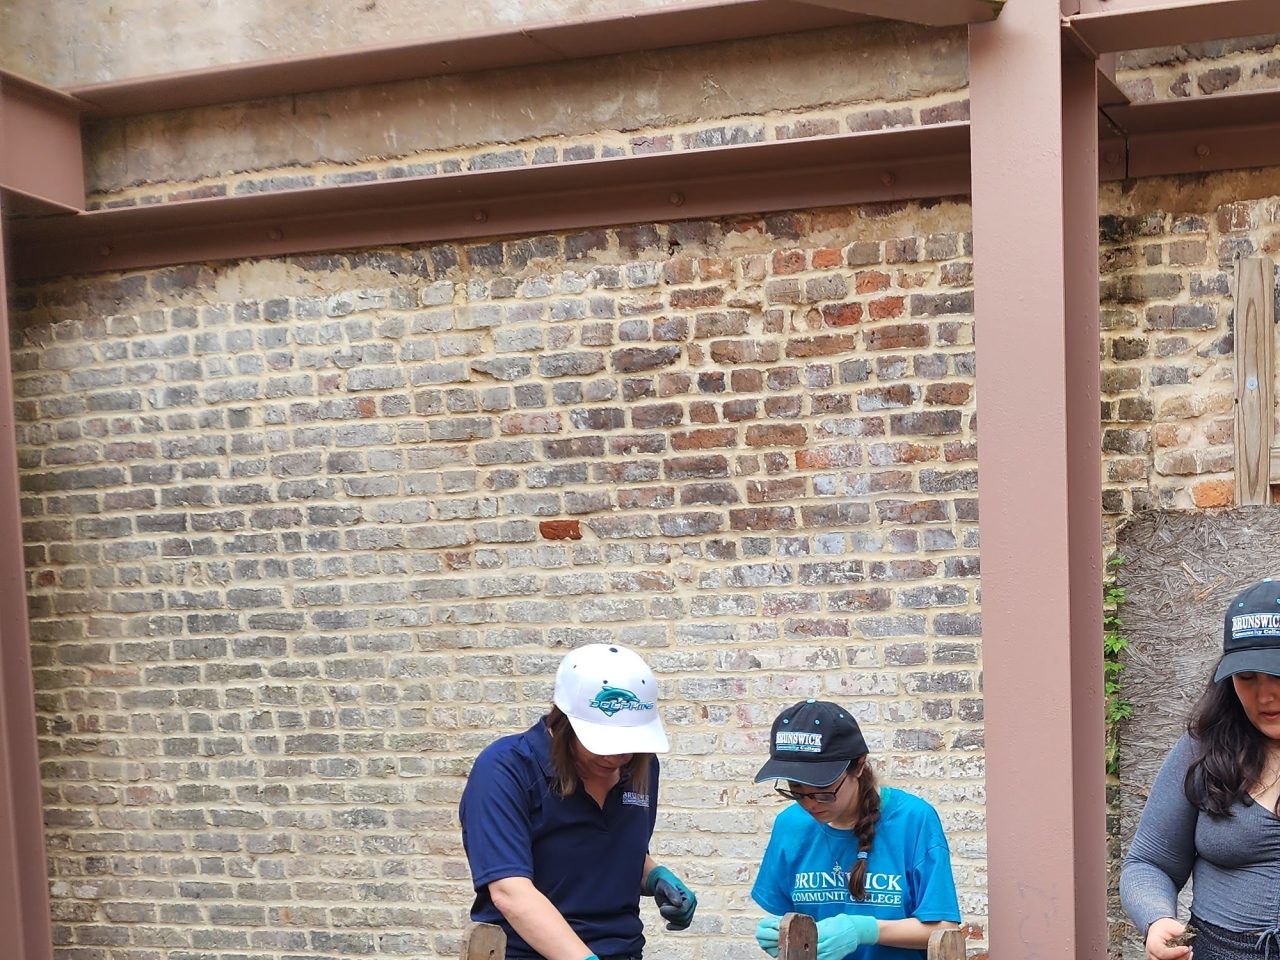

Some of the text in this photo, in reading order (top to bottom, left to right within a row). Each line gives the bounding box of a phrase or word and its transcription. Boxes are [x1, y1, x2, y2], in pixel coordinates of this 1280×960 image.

[589, 699, 654, 711] DOLPHINS
[776, 732, 822, 746] BRUNSWICK
[794, 871, 902, 891] BRUNSICK
